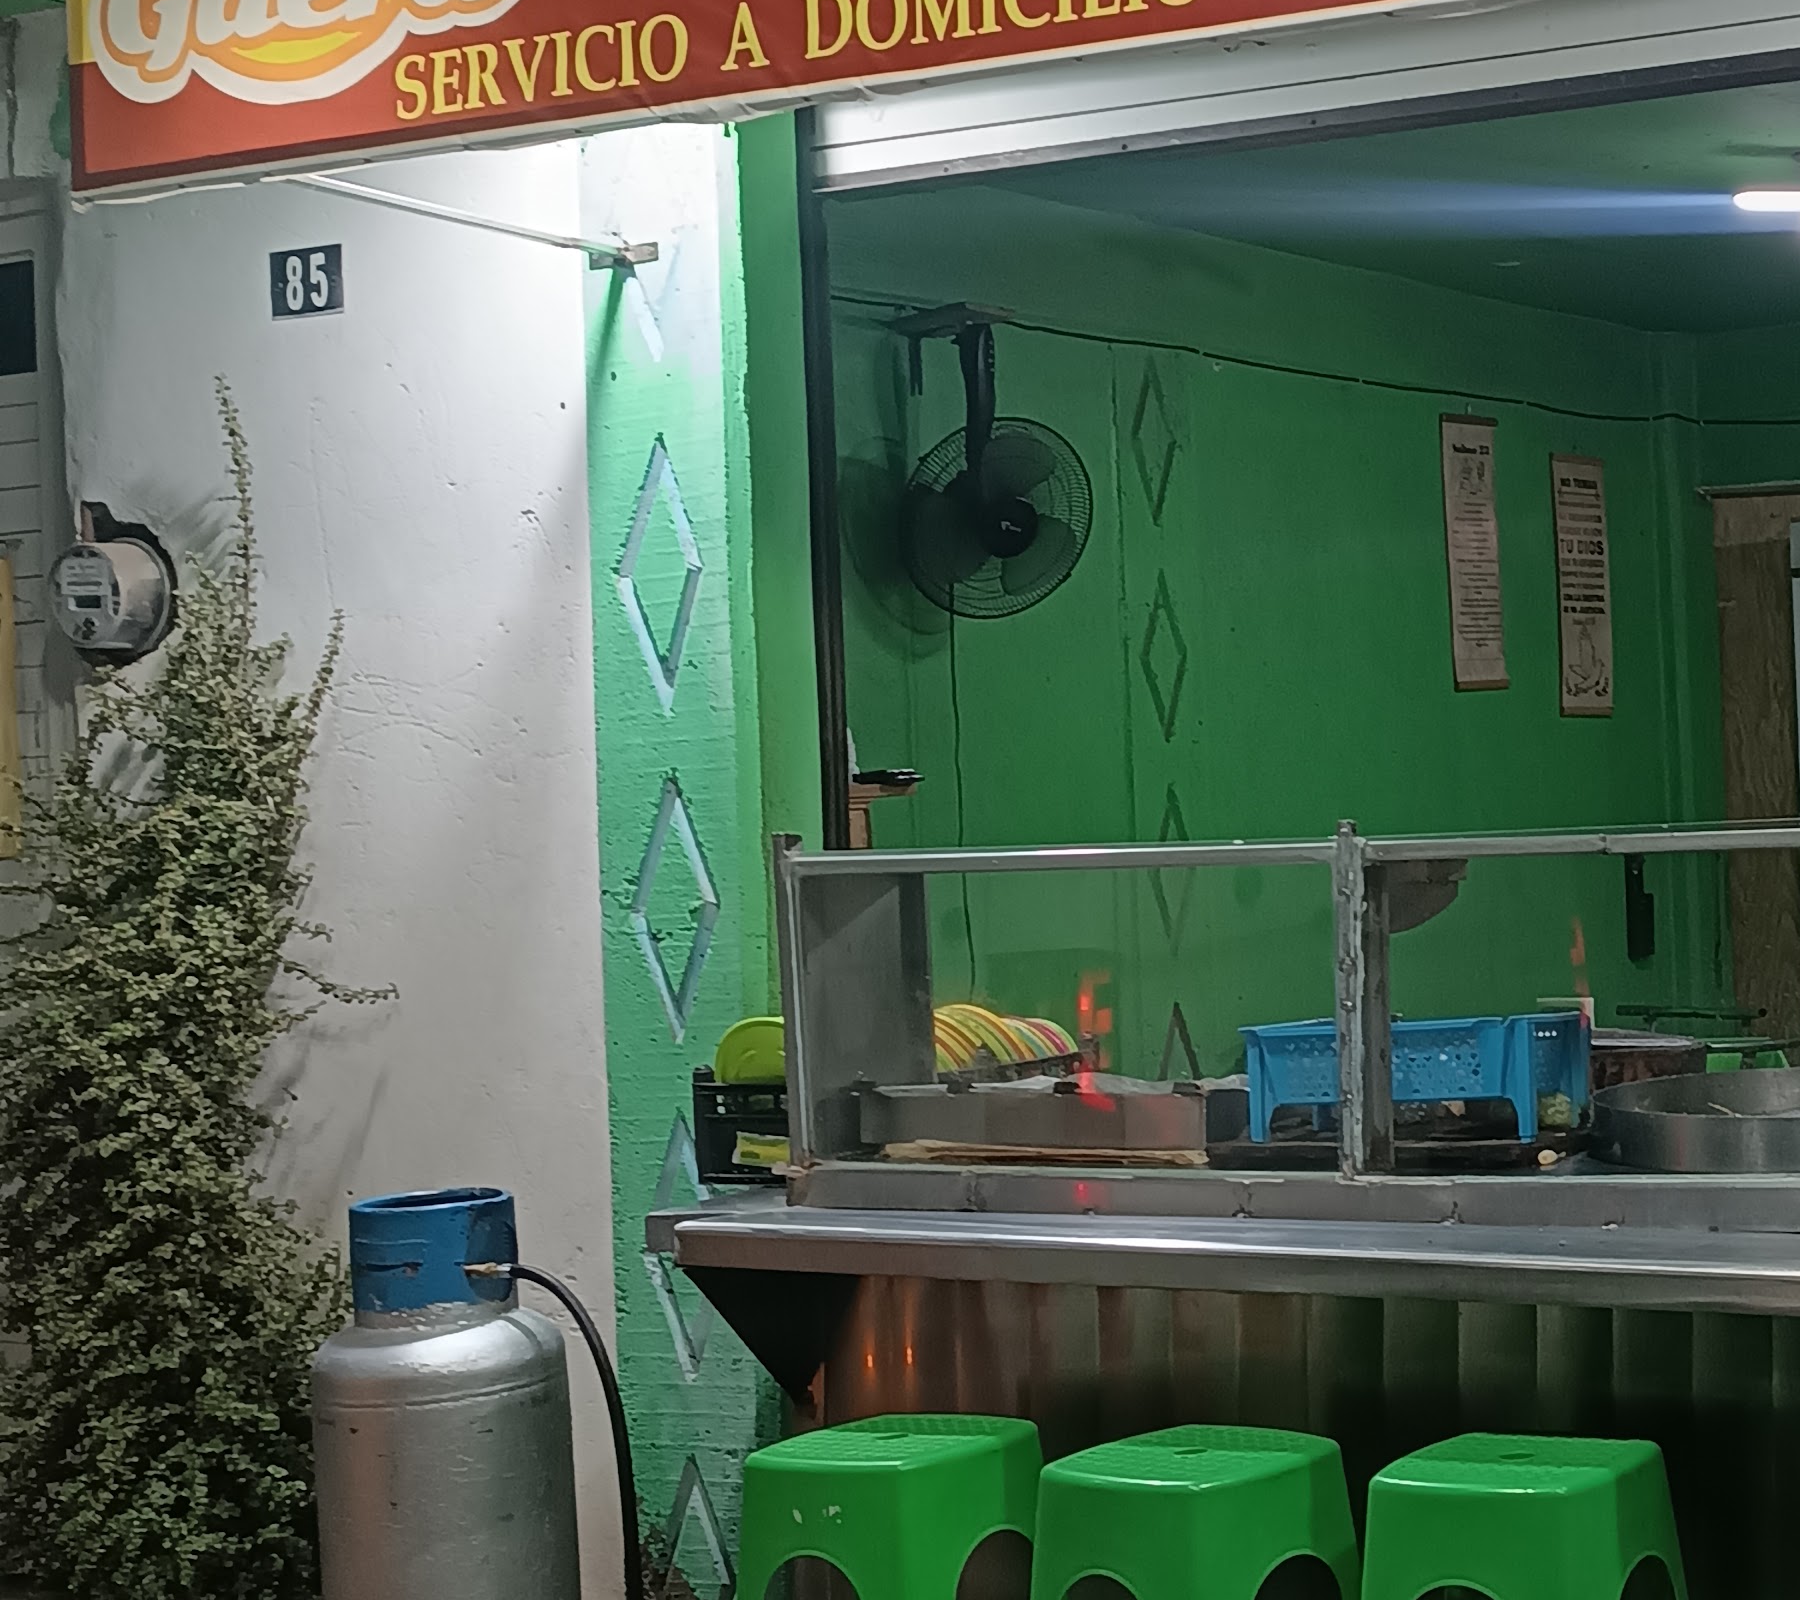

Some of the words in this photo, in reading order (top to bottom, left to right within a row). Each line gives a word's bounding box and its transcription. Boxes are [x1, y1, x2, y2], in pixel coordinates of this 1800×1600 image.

[395, 13, 689, 120] SERVICIO
[720, 4, 770, 72] A
[285, 252, 330, 312] 85
